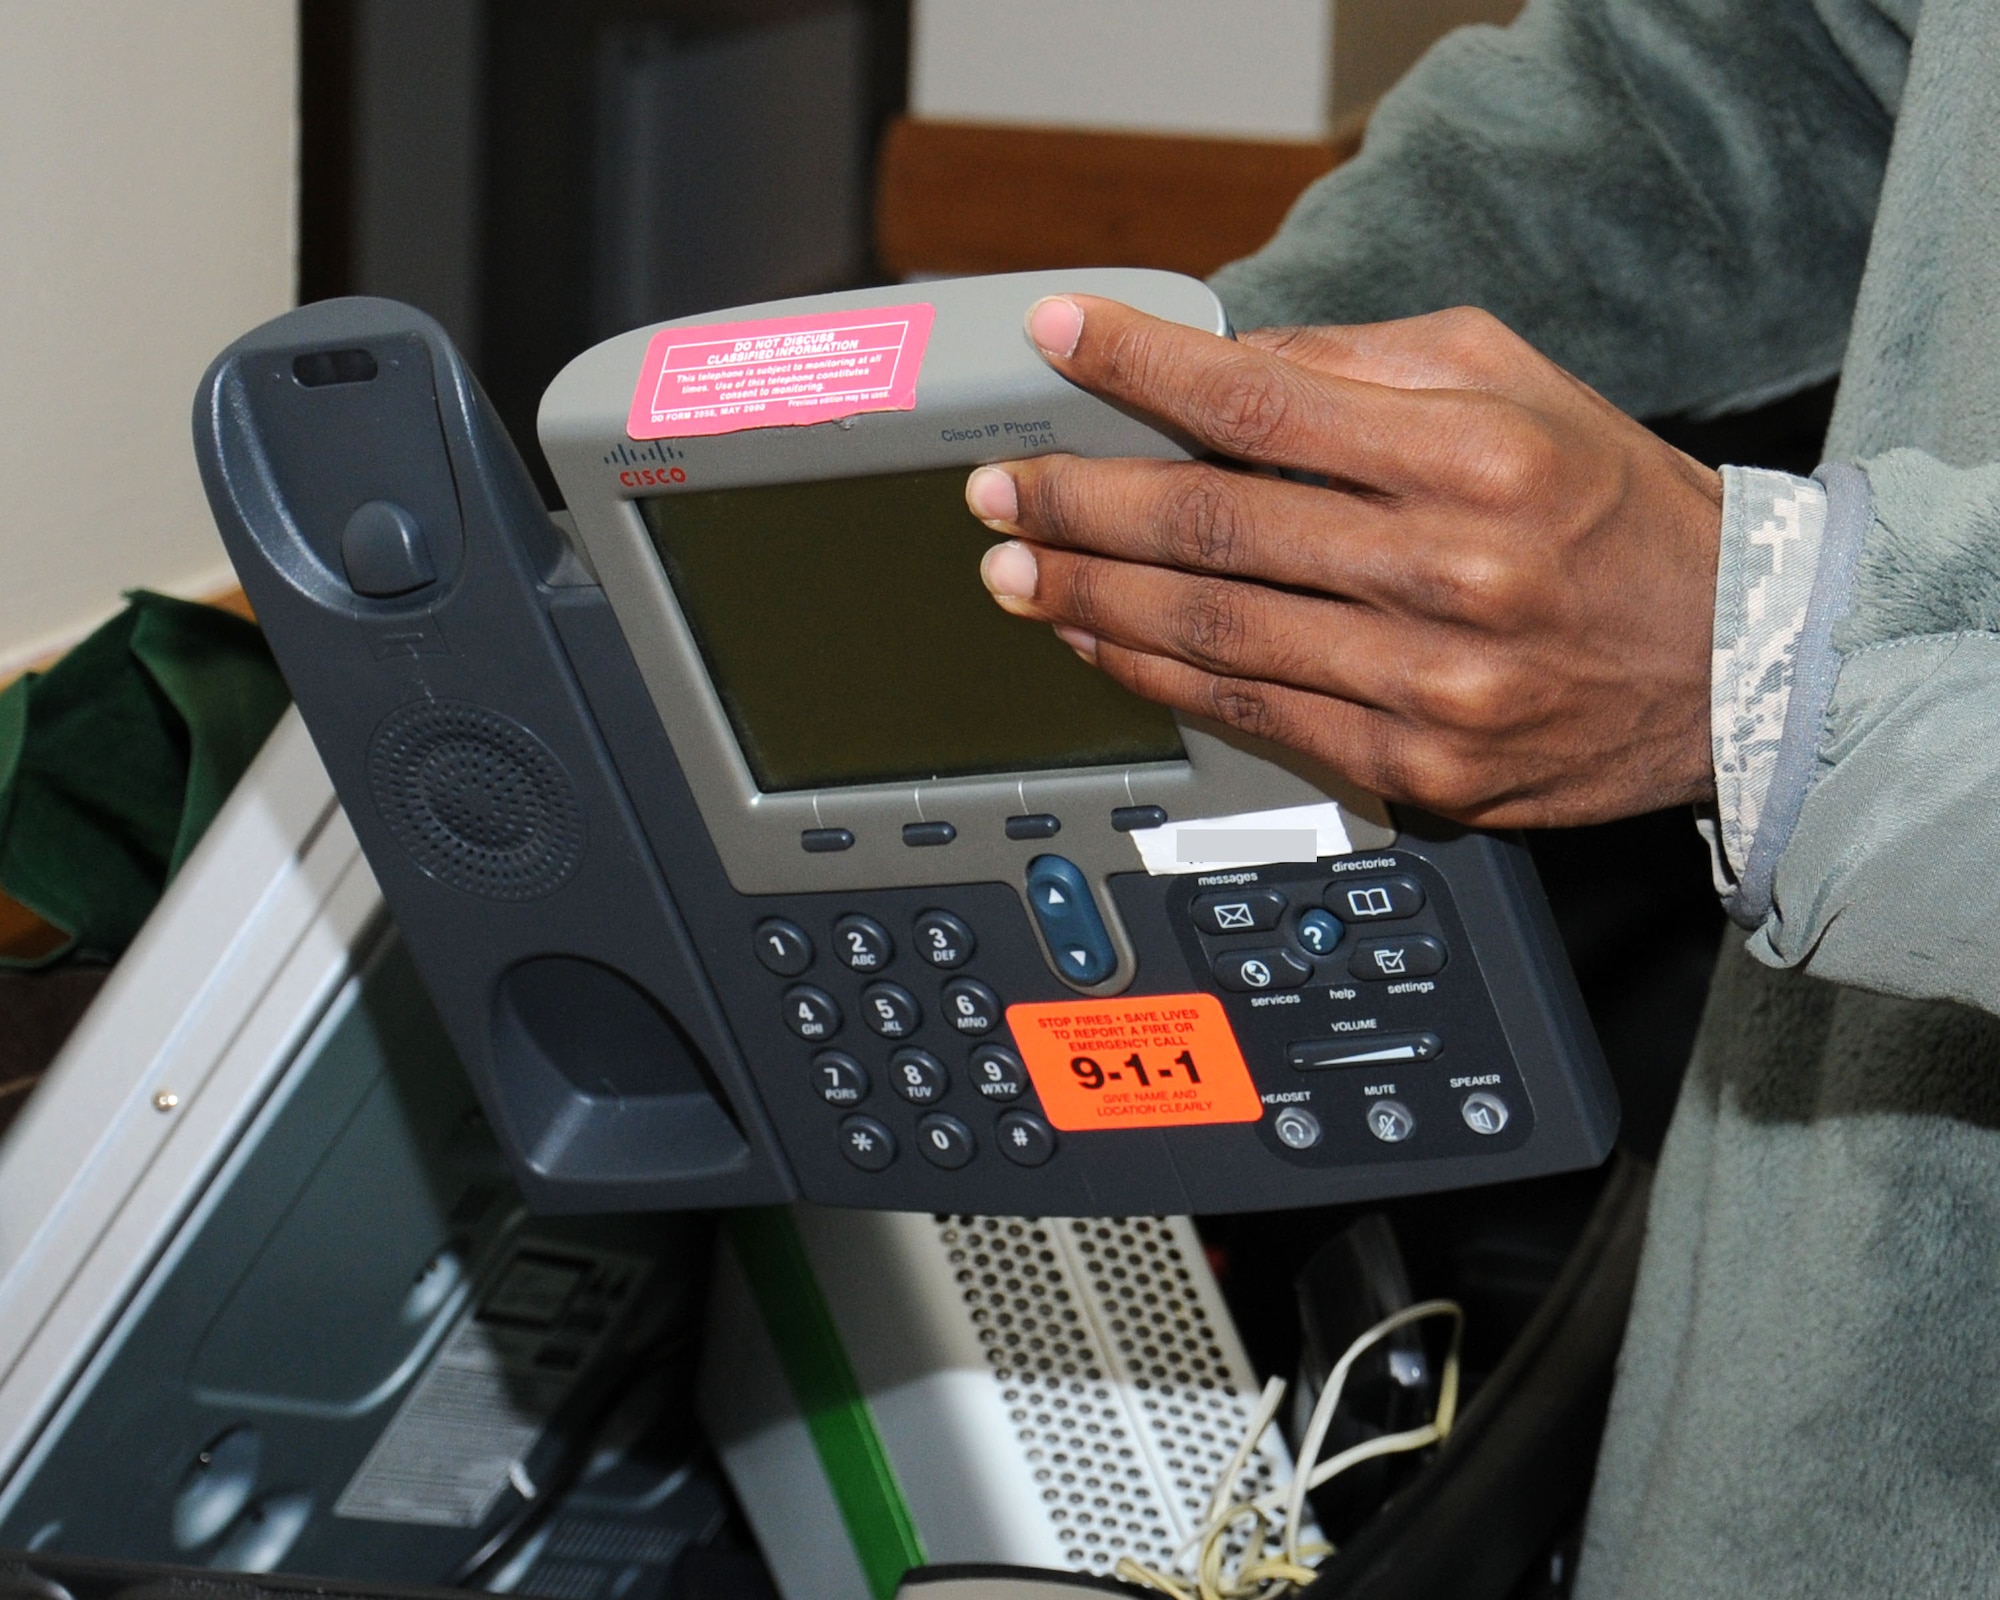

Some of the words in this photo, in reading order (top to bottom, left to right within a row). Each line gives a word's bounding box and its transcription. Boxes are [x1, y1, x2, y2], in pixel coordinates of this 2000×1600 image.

[734, 341, 752, 352] DO
[755, 338, 780, 349] NOT
[783, 332, 836, 347] DISCUSS
[707, 348, 774, 365] CLASSIFIED
[775, 340, 859, 357] INFORMATION
[676, 374, 696, 384] This
[697, 369, 743, 383] telephone
[746, 368, 755, 377] is
[756, 364, 791, 378] subject
[793, 362, 803, 371] to
[804, 357, 856, 370] monitoring
[857, 355, 867, 365] at
[869, 354, 882, 363] all
[682, 385, 709, 395] times.
[715, 382, 733, 391] Use
[735, 380, 746, 389] of
[747, 378, 765, 387] this
[767, 372, 814, 386] telephone
[816, 367, 870, 381] constitutes
[719, 389, 758, 401] consent
[760, 387, 769, 396] to
[771, 383, 825, 396] monitoring.
[787, 398, 818, 407] Previous
[844, 393, 859, 403] may
[860, 392, 869, 400] be
[651, 414, 664, 423] DD
[665, 411, 691, 421] FORM
[720, 406, 741, 415] MAY
[941, 428, 983, 442] Cisco
[984, 424, 1000, 437] IP
[1003, 420, 1052, 435] Phone
[1019, 433, 1057, 448] 7941
[620, 466, 687, 487] CISCO
[1331, 857, 1397, 873] directories
[1198, 871, 1258, 886] messages
[769, 936, 785, 956] 1
[847, 932, 867, 953] 2
[928, 928, 948, 948] 3
[851, 954, 876, 966] ABC
[933, 949, 956, 962] DEF
[1329, 988, 1356, 1001] help
[1387, 980, 1435, 995] settings
[956, 995, 975, 1015] 6
[1251, 993, 1301, 1007] services
[798, 1002, 814, 1021] 4
[875, 999, 894, 1019] 5
[881, 1020, 902, 1032] JKL
[957, 1017, 988, 1029] MNO
[1037, 1016, 1071, 1029] STOP
[1075, 1014, 1112, 1026] FIRES
[1123, 1011, 1159, 1023] SAVE
[1161, 1009, 1199, 1021] LIVES
[1331, 1018, 1377, 1032] VOLUME
[801, 1023, 823, 1034] GHI
[1052, 1029, 1070, 1040] TO
[1074, 1026, 1125, 1039] REPORT
[1130, 1026, 1139, 1036] A
[1142, 1023, 1171, 1034] FIRE
[1174, 1022, 1195, 1033] OR
[1068, 1039, 1149, 1052] EMERGENCY
[1153, 1036, 1189, 1047] CALL
[823, 1067, 839, 1087] 7
[903, 1065, 922, 1084] 8
[983, 1061, 1003, 1081] 9
[1070, 1050, 1202, 1090] 9-1-1
[981, 1082, 1017, 1095] WXYZ
[1449, 1074, 1501, 1088] SPEAKER
[907, 1086, 932, 1098] TUV
[1102, 1093, 1132, 1104] GIVE
[1135, 1091, 1170, 1102] NAME
[1172, 1089, 1197, 1100] AND
[1261, 1091, 1312, 1104] HEADSET
[1364, 1084, 1396, 1096] MUTE
[1097, 1104, 1157, 1117] LOCATION
[1159, 1101, 1213, 1114] CLEARLY
[931, 1129, 949, 1150] 0
[1011, 1127, 1028, 1146] #
